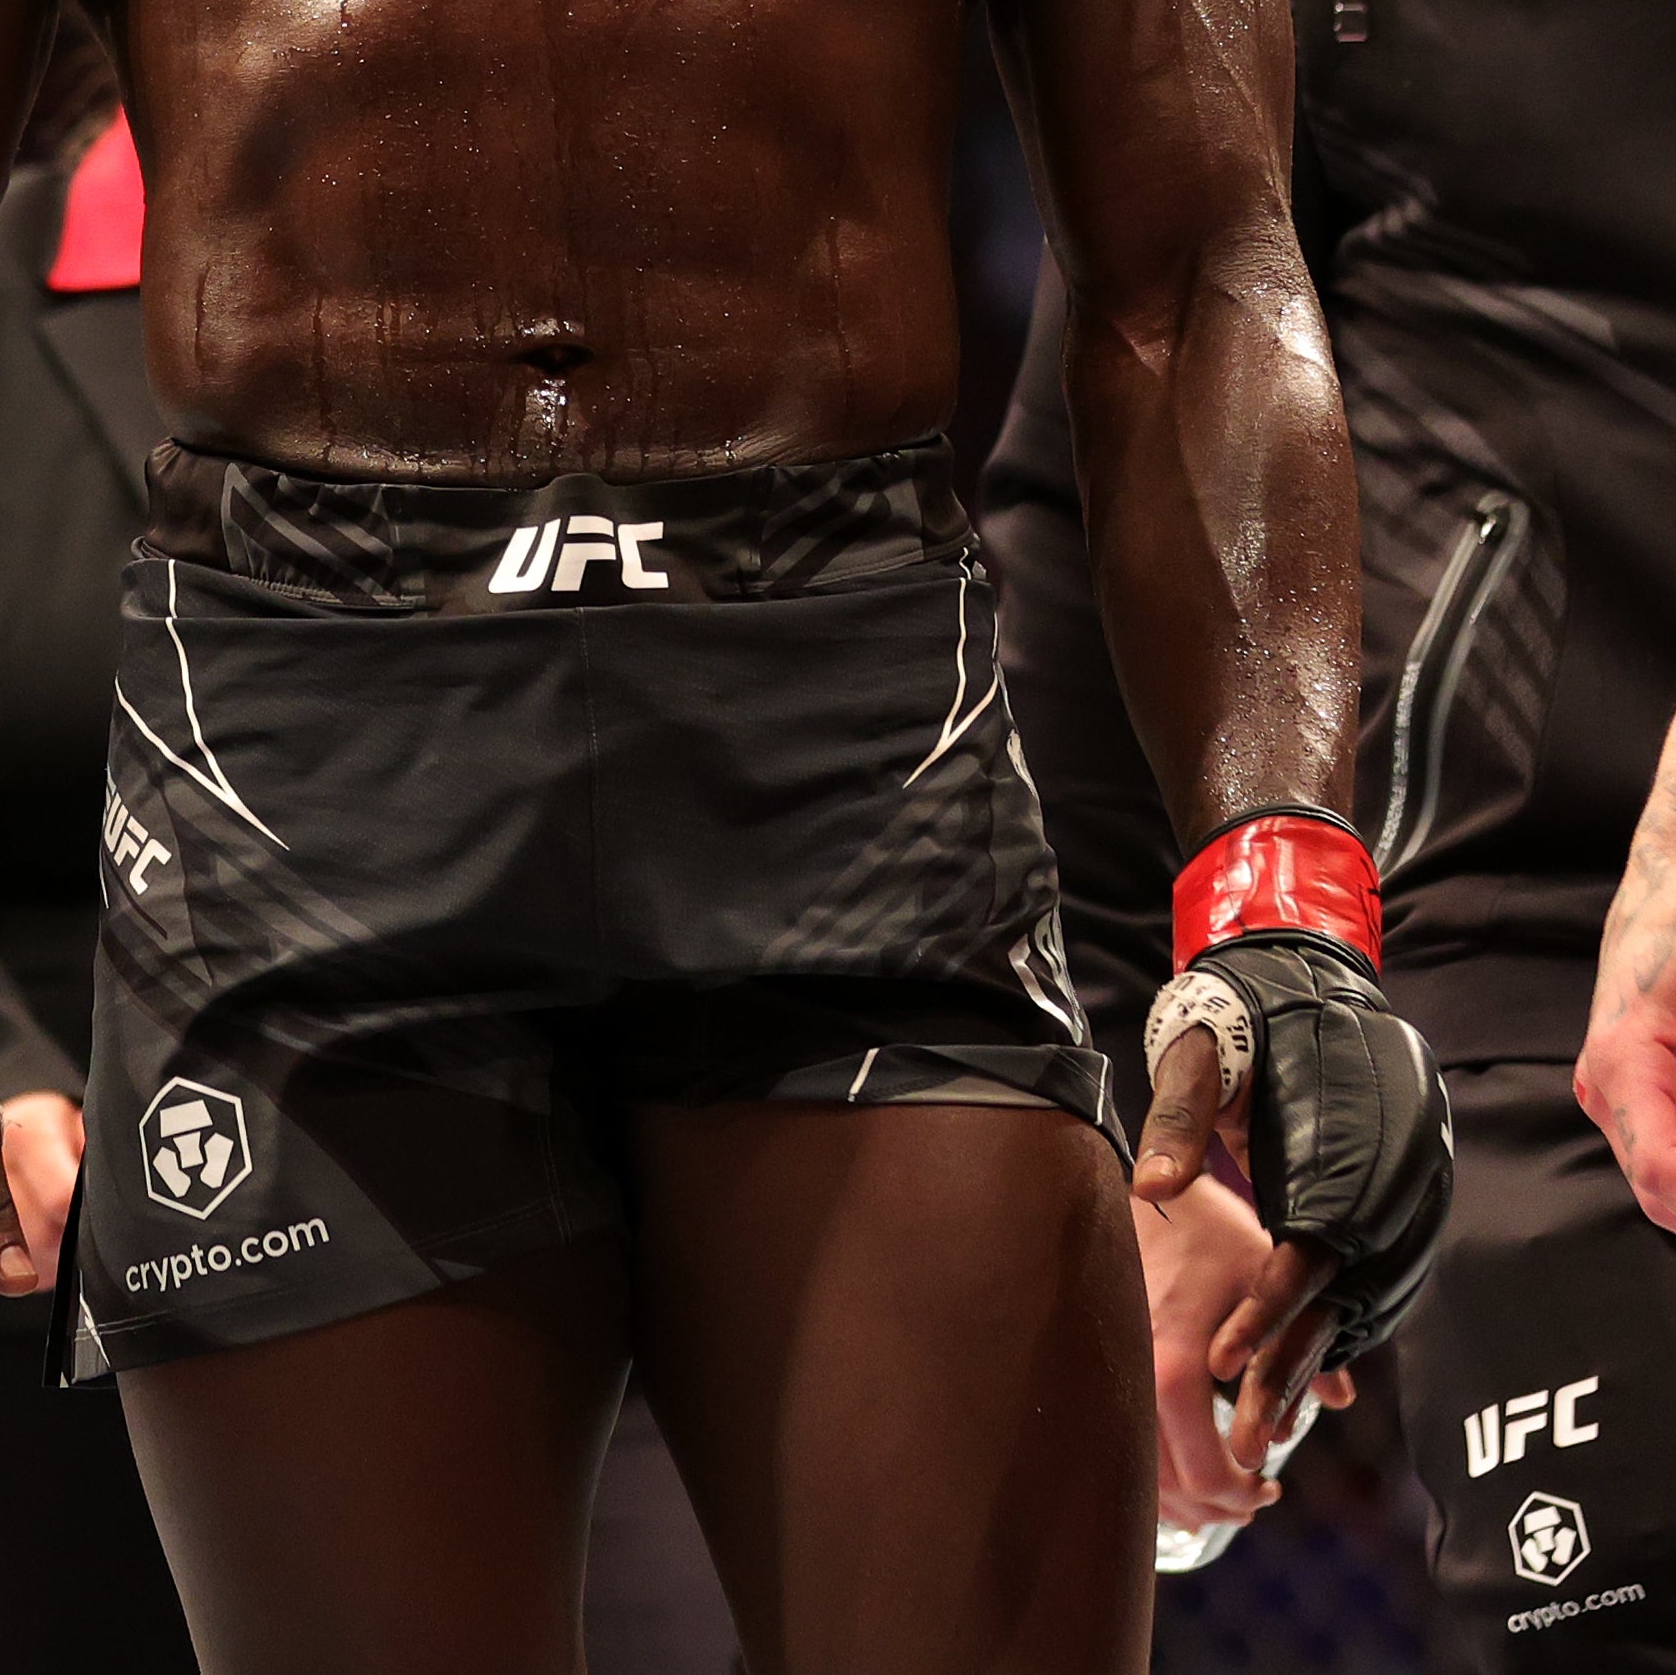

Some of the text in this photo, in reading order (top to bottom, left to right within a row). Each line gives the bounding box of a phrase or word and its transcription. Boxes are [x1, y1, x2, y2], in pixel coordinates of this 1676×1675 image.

[488, 514, 670, 594] UFC
[103, 792, 172, 896] UFC
[125, 1217, 331, 1293] crypto.com
[1463, 1375, 1599, 1479] UFC
[1507, 1583, 1647, 1634] crypto.com
